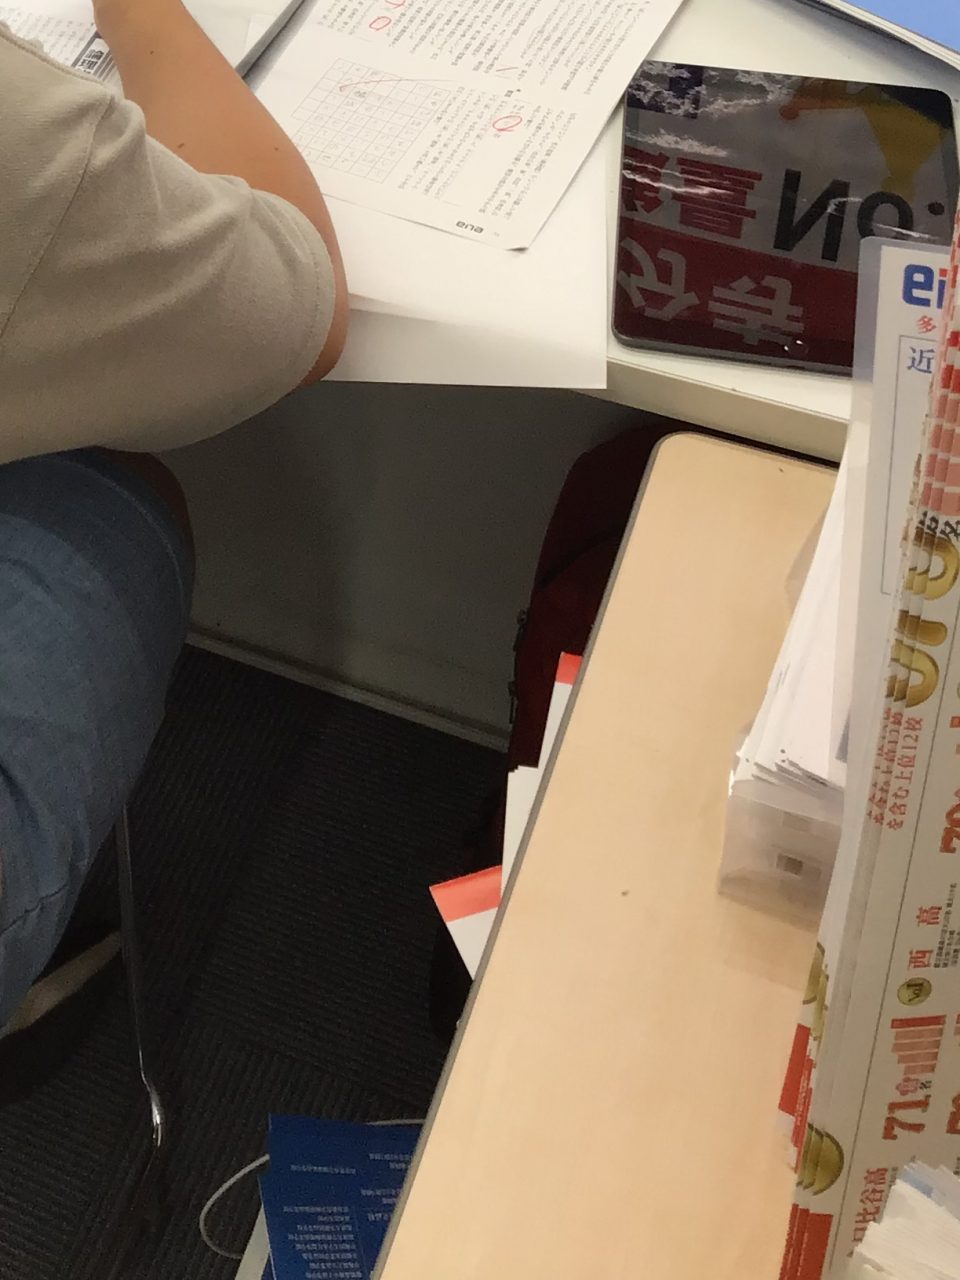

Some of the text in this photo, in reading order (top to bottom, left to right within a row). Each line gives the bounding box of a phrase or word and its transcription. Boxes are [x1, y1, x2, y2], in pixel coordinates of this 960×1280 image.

[455, 220, 484, 234] ena
[907, 346, 936, 374] 近
[881, 1094, 931, 1141] 71
